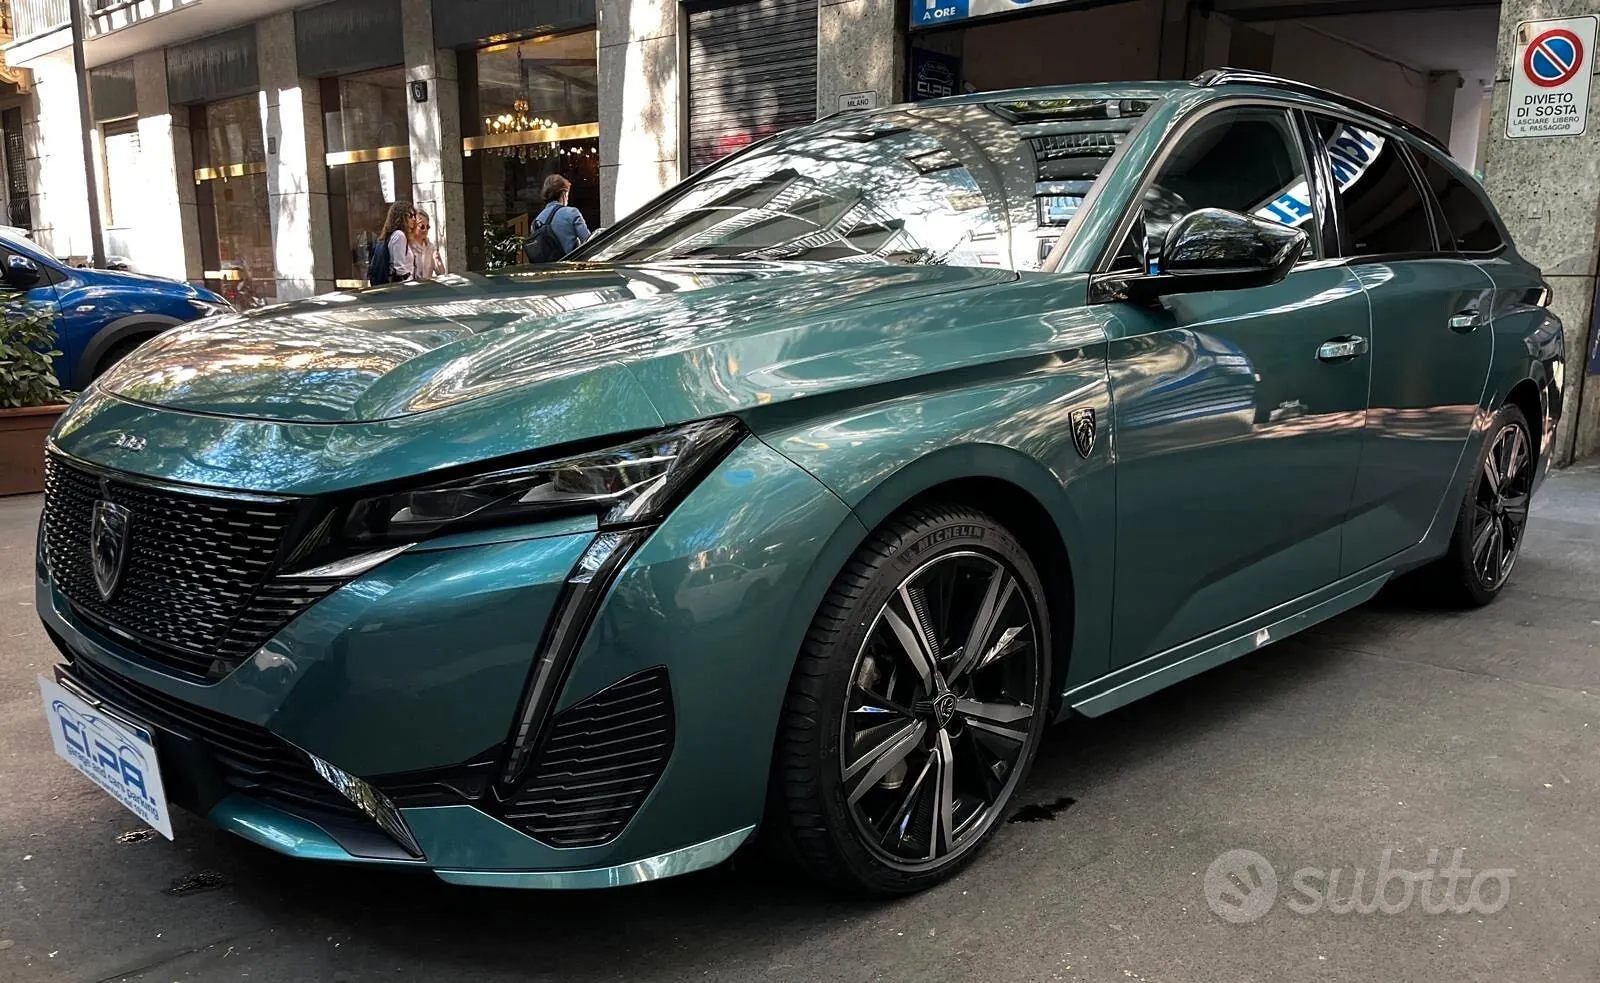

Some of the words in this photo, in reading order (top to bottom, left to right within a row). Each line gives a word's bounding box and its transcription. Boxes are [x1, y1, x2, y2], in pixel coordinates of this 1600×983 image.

[922, 11, 932, 21] A
[934, 6, 956, 18] ORE
[847, 98, 869, 107] MILANO
[1524, 92, 1573, 105] DIVIETO
[1517, 107, 1529, 117] DI
[1535, 104, 1577, 117] SOSTA
[1512, 116, 1550, 126] LASCIARE
[1552, 115, 1580, 124] LIBERO
[1529, 123, 1571, 132] PASSAGGIO
[918, 525, 982, 552] MICHELIN
[107, 774, 126, 793] cars
[126, 788, 160, 821] parking
